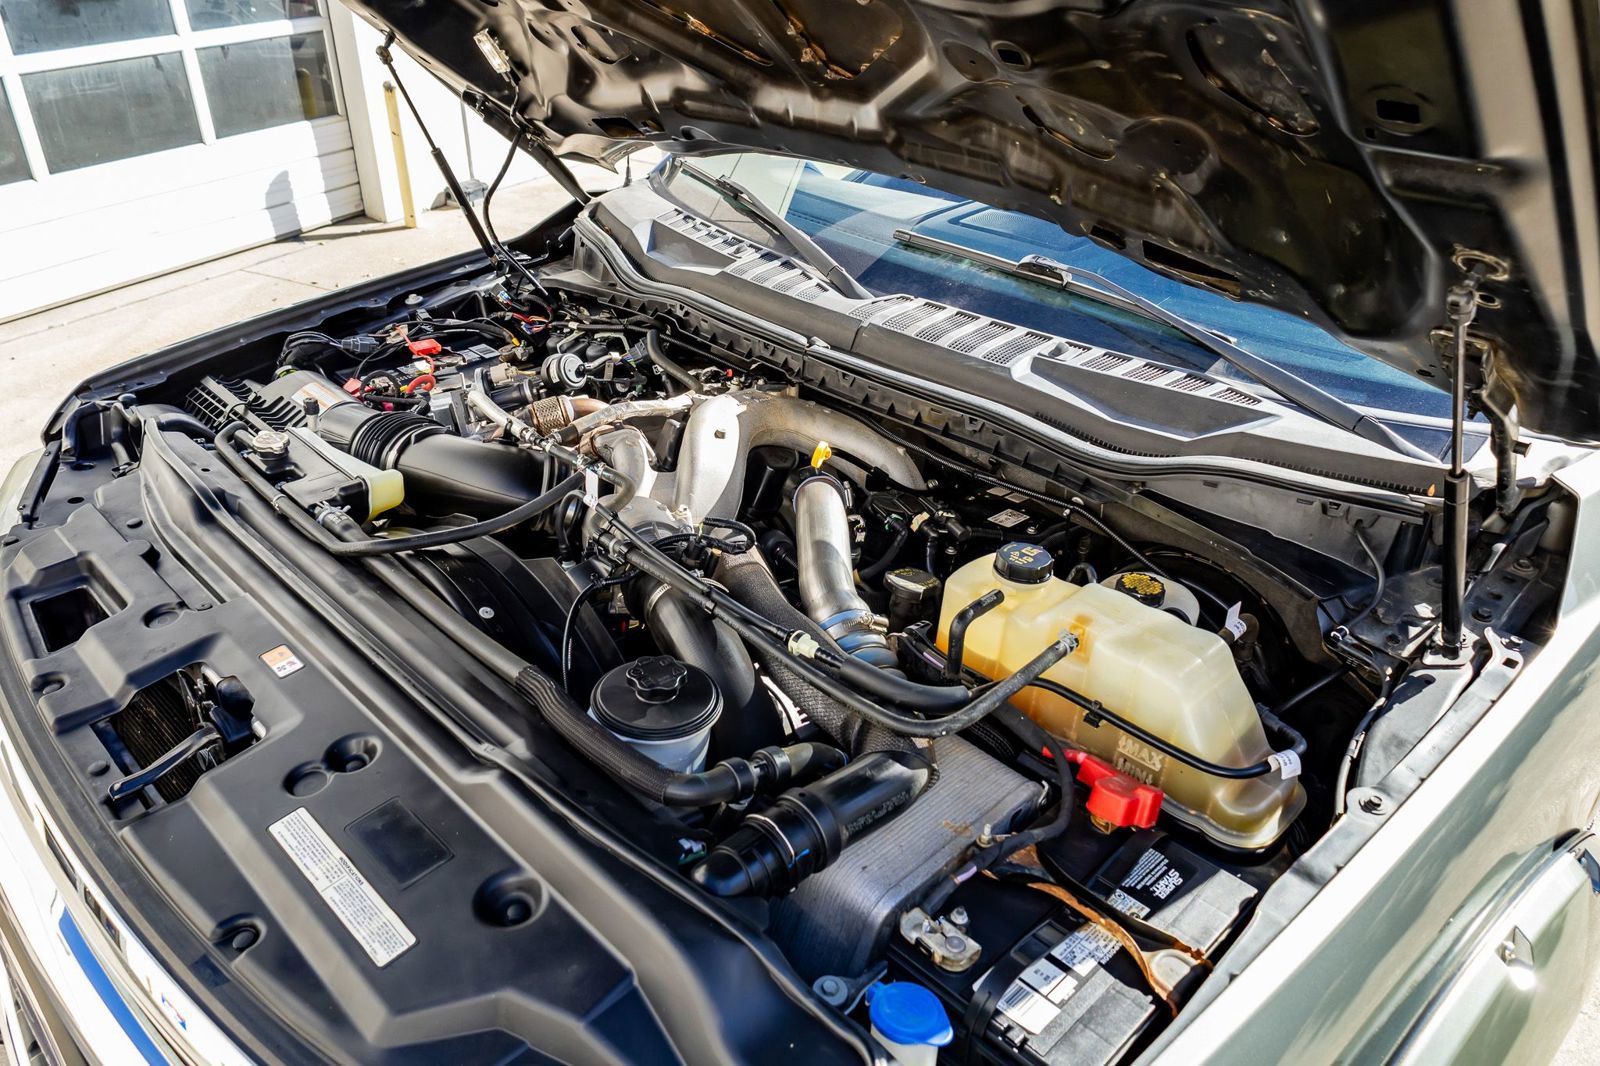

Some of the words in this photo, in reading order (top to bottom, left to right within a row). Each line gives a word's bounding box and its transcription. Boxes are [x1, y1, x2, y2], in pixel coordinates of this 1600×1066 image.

[1125, 738, 1164, 770] MAX
[1151, 868, 1181, 897] START
[1157, 876, 1184, 900] SUPER
